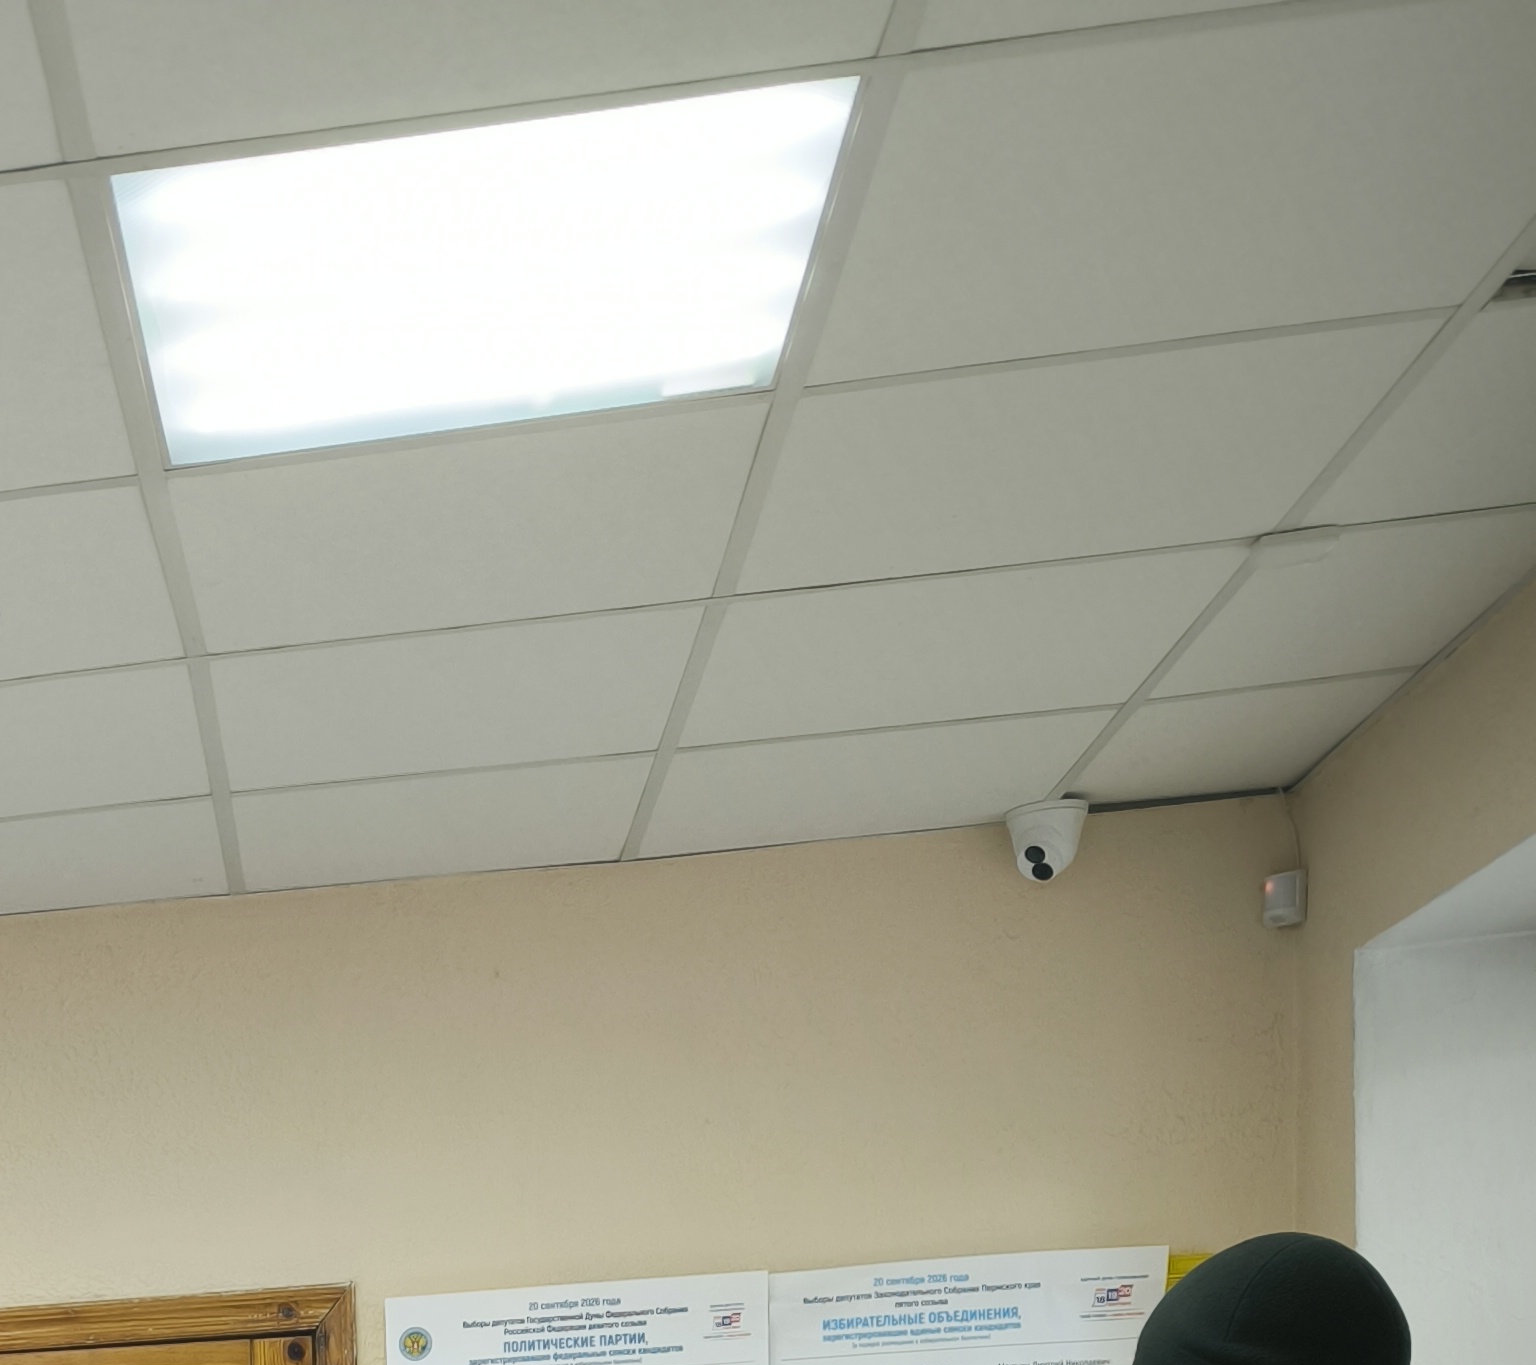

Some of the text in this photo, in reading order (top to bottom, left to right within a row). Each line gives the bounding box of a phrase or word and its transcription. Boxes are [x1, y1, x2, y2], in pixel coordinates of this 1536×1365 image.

[872, 1273, 969, 1287] 20 сентября 2026 года
[981, 1282, 1022, 1292] Пермского
[528, 1301, 539, 1311] 20
[580, 1297, 601, 1307] 2026
[822, 1306, 1021, 1331] ИЗБИРАТЕЛЬНЫЕ ОБЪЕДИНЕНИЯ,
[503, 1332, 648, 1353] ПОЛИТИЧЕСКИЕ ПАРТИИ,
